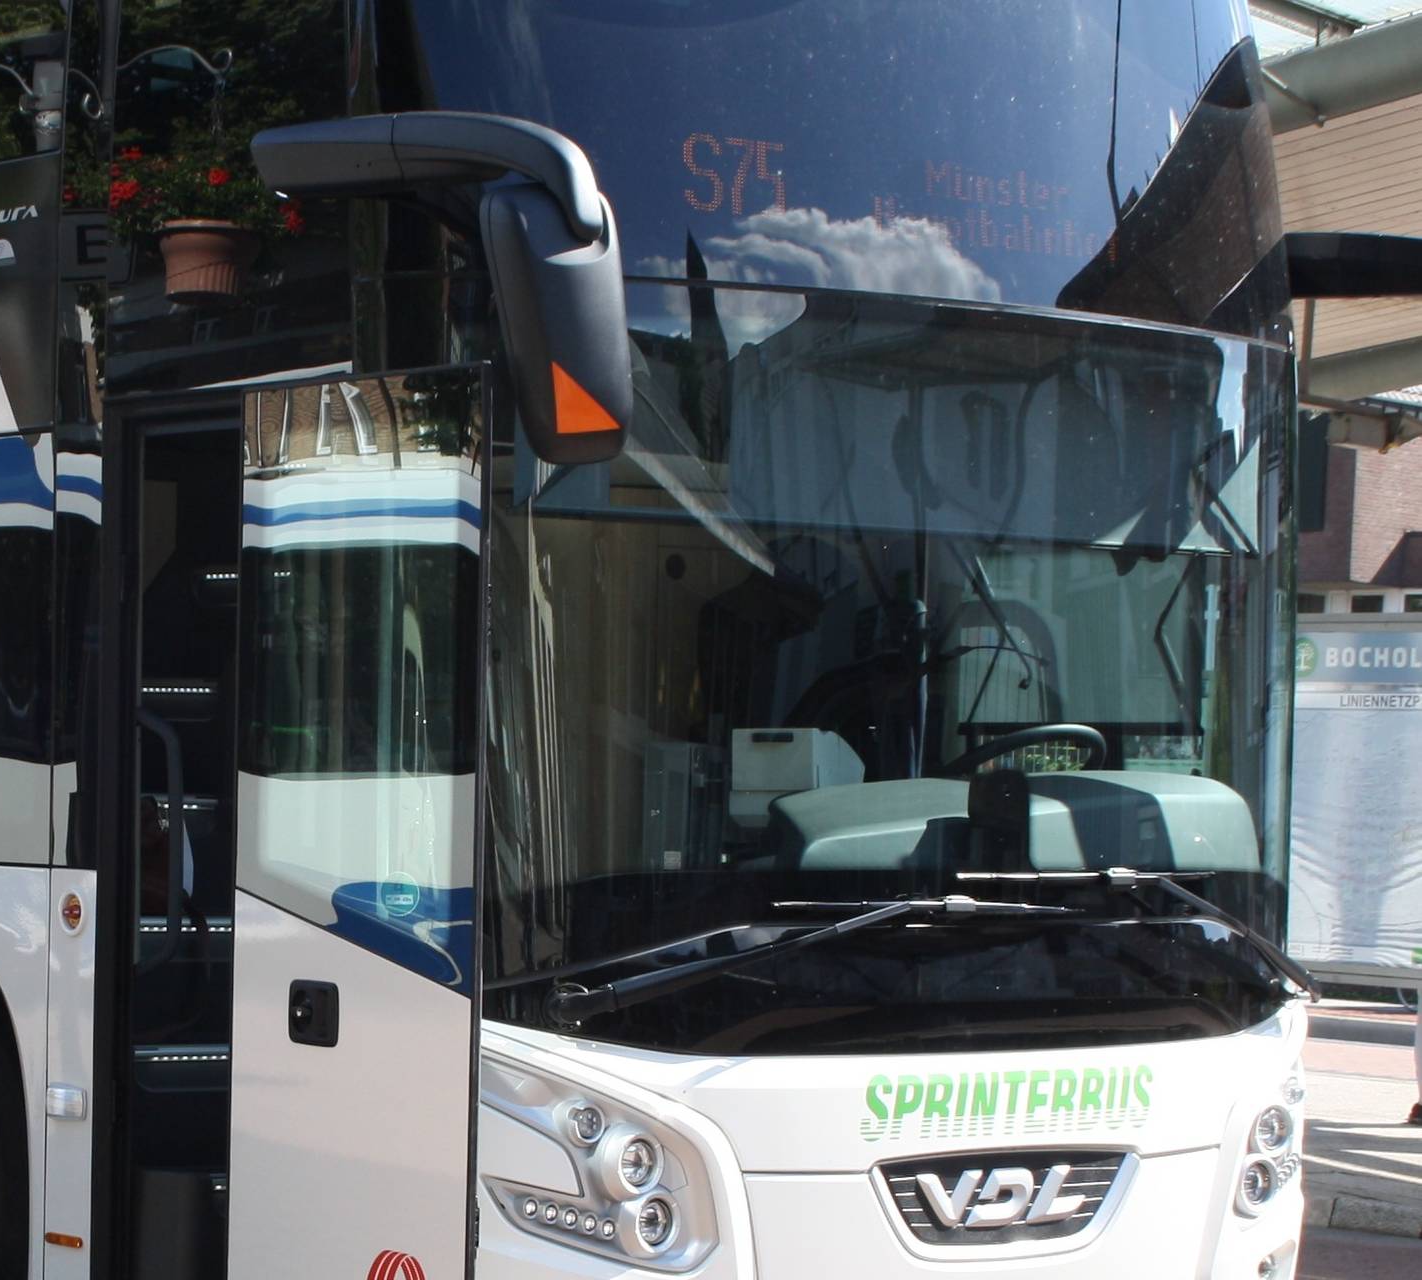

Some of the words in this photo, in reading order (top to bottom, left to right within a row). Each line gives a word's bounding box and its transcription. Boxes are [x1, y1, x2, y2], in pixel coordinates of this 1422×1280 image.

[682, 131, 786, 216] S75
[925, 160, 1070, 209] Münster
[875, 195, 1119, 267] Hptbahnhof
[1325, 646, 1422, 668] BOCHOL
[1339, 694, 1420, 708] LINIENNETZP
[860, 1064, 1155, 1143] SPRINTERBUS
[914, 1165, 1087, 1228] VDL
